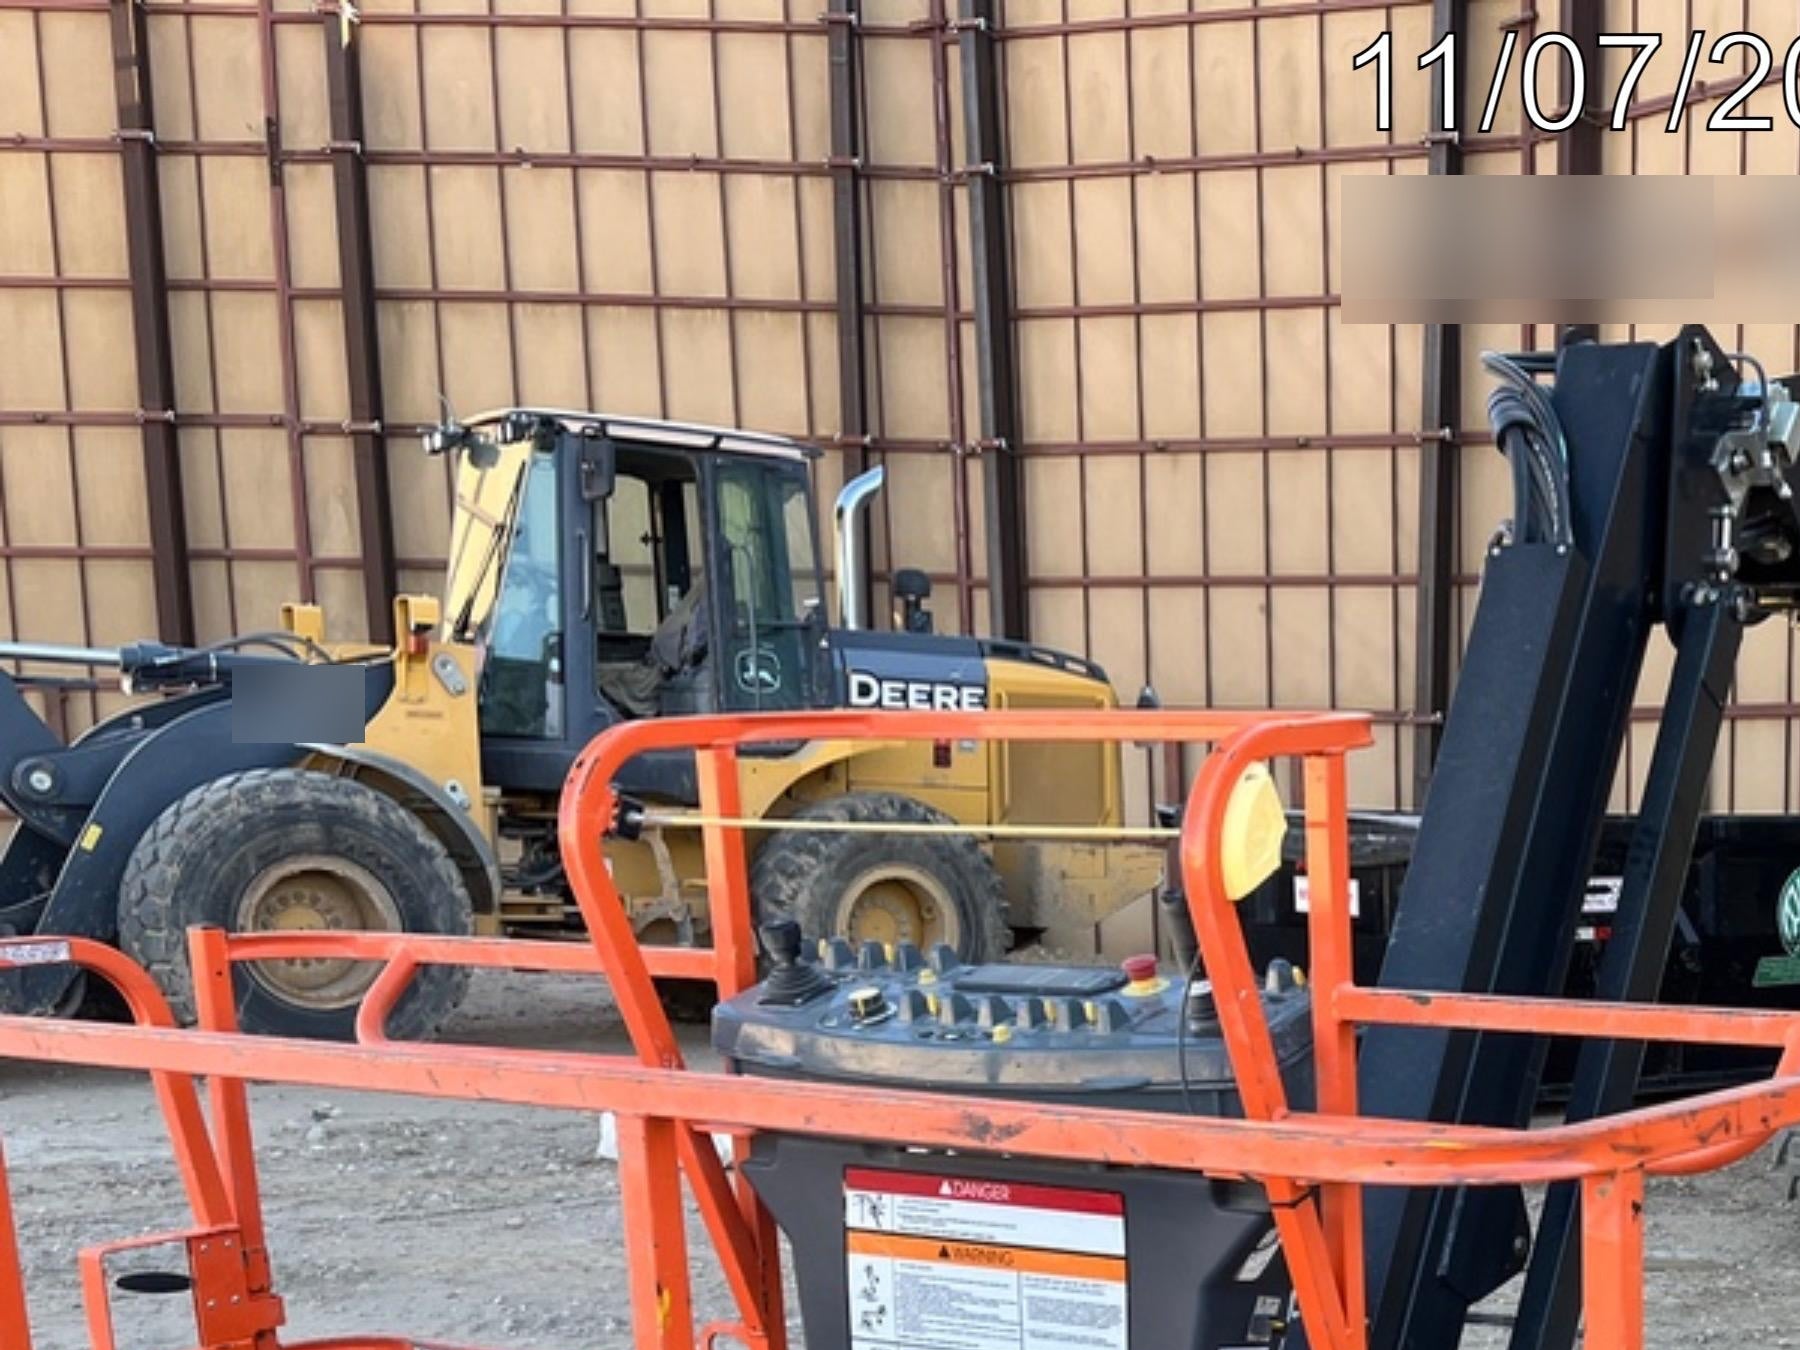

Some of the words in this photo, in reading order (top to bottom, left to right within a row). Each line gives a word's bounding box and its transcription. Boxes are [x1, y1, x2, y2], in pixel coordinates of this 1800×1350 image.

[849, 673, 985, 711] DEERE
[953, 1182, 1009, 1201] DANGER
[953, 1246, 1015, 1267] WARNING
